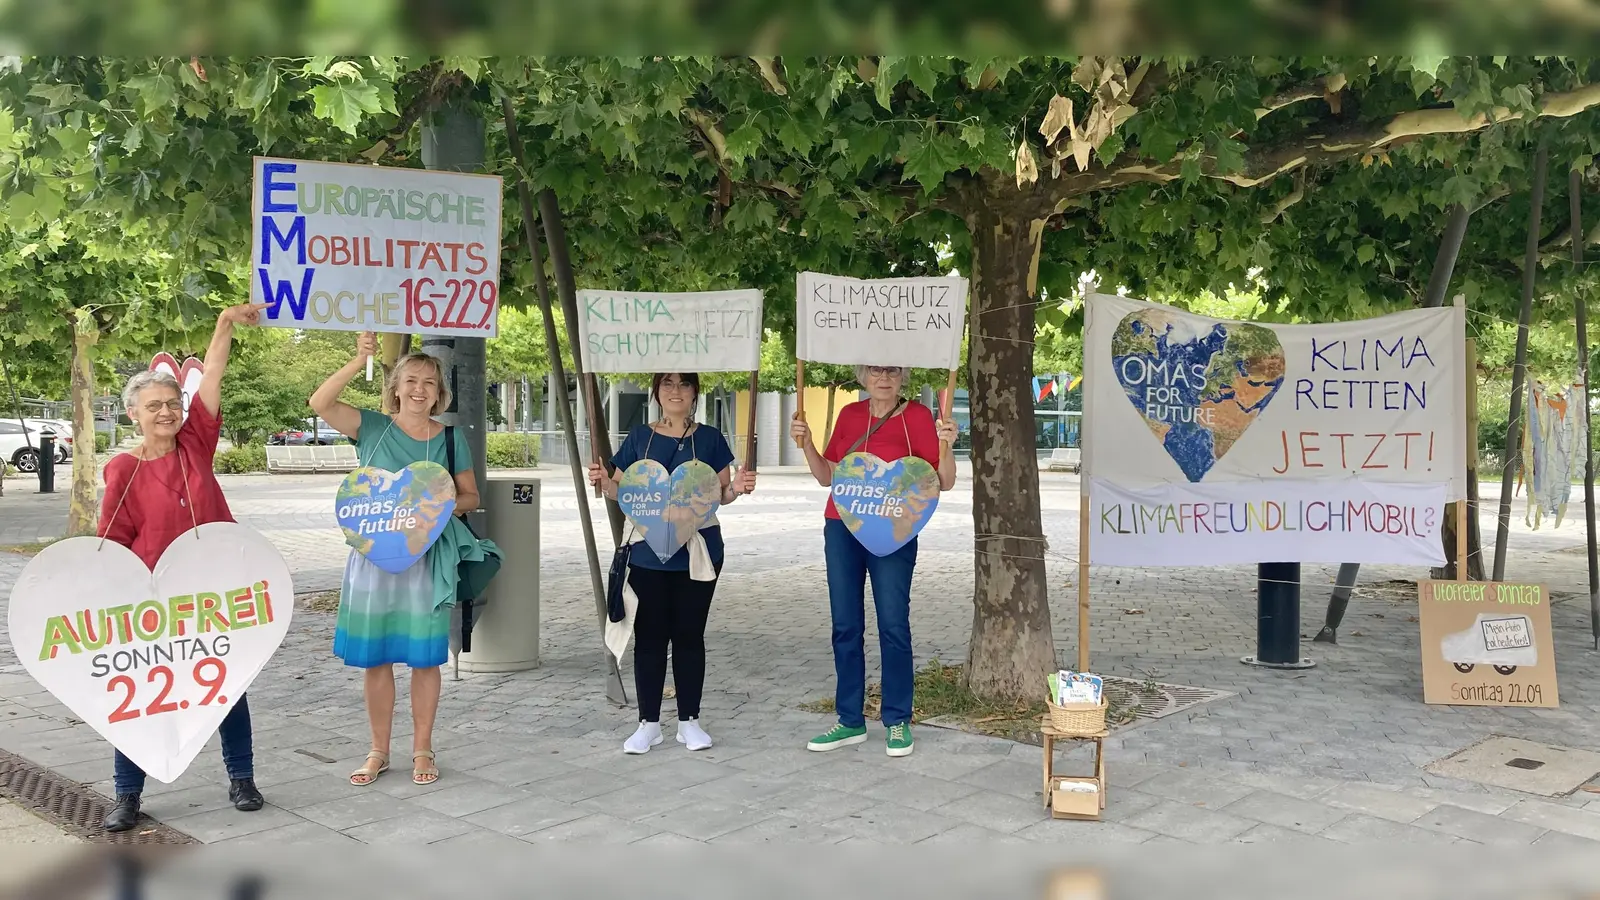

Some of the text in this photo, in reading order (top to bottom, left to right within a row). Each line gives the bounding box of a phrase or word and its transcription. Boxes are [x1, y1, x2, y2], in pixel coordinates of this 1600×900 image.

[261, 215, 488, 275] MOBILITÄTS
[258, 268, 399, 325] WOCHE
[813, 282, 950, 309] KLIMASCHUTZ
[813, 310, 951, 331] GEHT ALLE AN
[587, 331, 709, 357] SCHÜTZEN
[1310, 336, 1436, 372] KLIMA
[1121, 355, 1208, 392] OMAS
[1146, 386, 1183, 406] FOR
[1296, 378, 1426, 410] RETTEN
[1145, 403, 1216, 426] FUTURE
[1272, 430, 1435, 475] JETZT!
[622, 491, 662, 503] OMAS
[834, 483, 903, 507] omas for
[339, 499, 415, 519] omas for
[631, 509, 661, 517] FUTURE
[850, 499, 904, 518] future
[358, 515, 417, 535] future
[1488, 583, 1541, 606] Sonntag
[1485, 620, 1522, 635] Mein Auto
[1496, 634, 1513, 648] heute
[91, 635, 231, 678] SONNTAG
[106, 656, 228, 724] 22.9.
[1450, 682, 1543, 704] Sonntag 22.09
